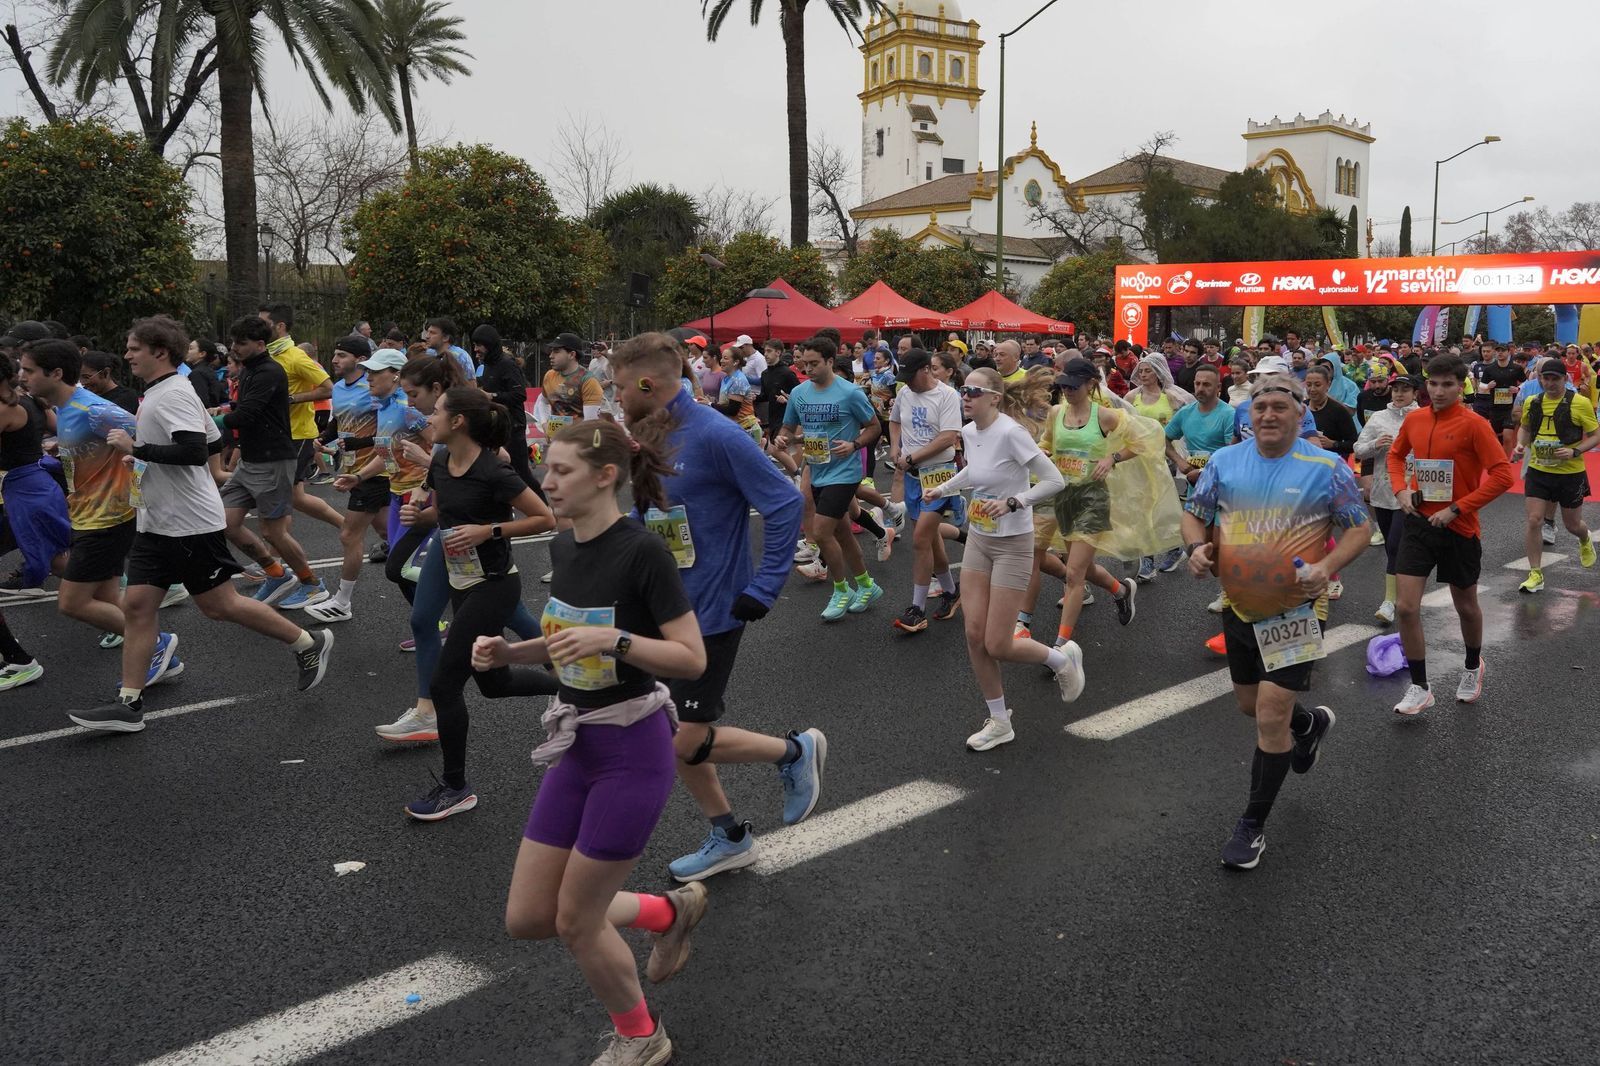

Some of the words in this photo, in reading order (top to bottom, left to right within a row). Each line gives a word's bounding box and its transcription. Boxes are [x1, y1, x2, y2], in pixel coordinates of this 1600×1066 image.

[1383, 266, 1456, 281] maratón
[1473, 274, 1534, 286] 00:11:34
[1195, 279, 1232, 289] Sprinter
[1271, 275, 1316, 291] HOKA
[1400, 279, 1458, 293] sevilla
[800, 404, 831, 413] CARRERAS
[805, 413, 838, 422] POPULARES
[923, 471, 952, 485] 17069
[1261, 618, 1308, 646] 20327
